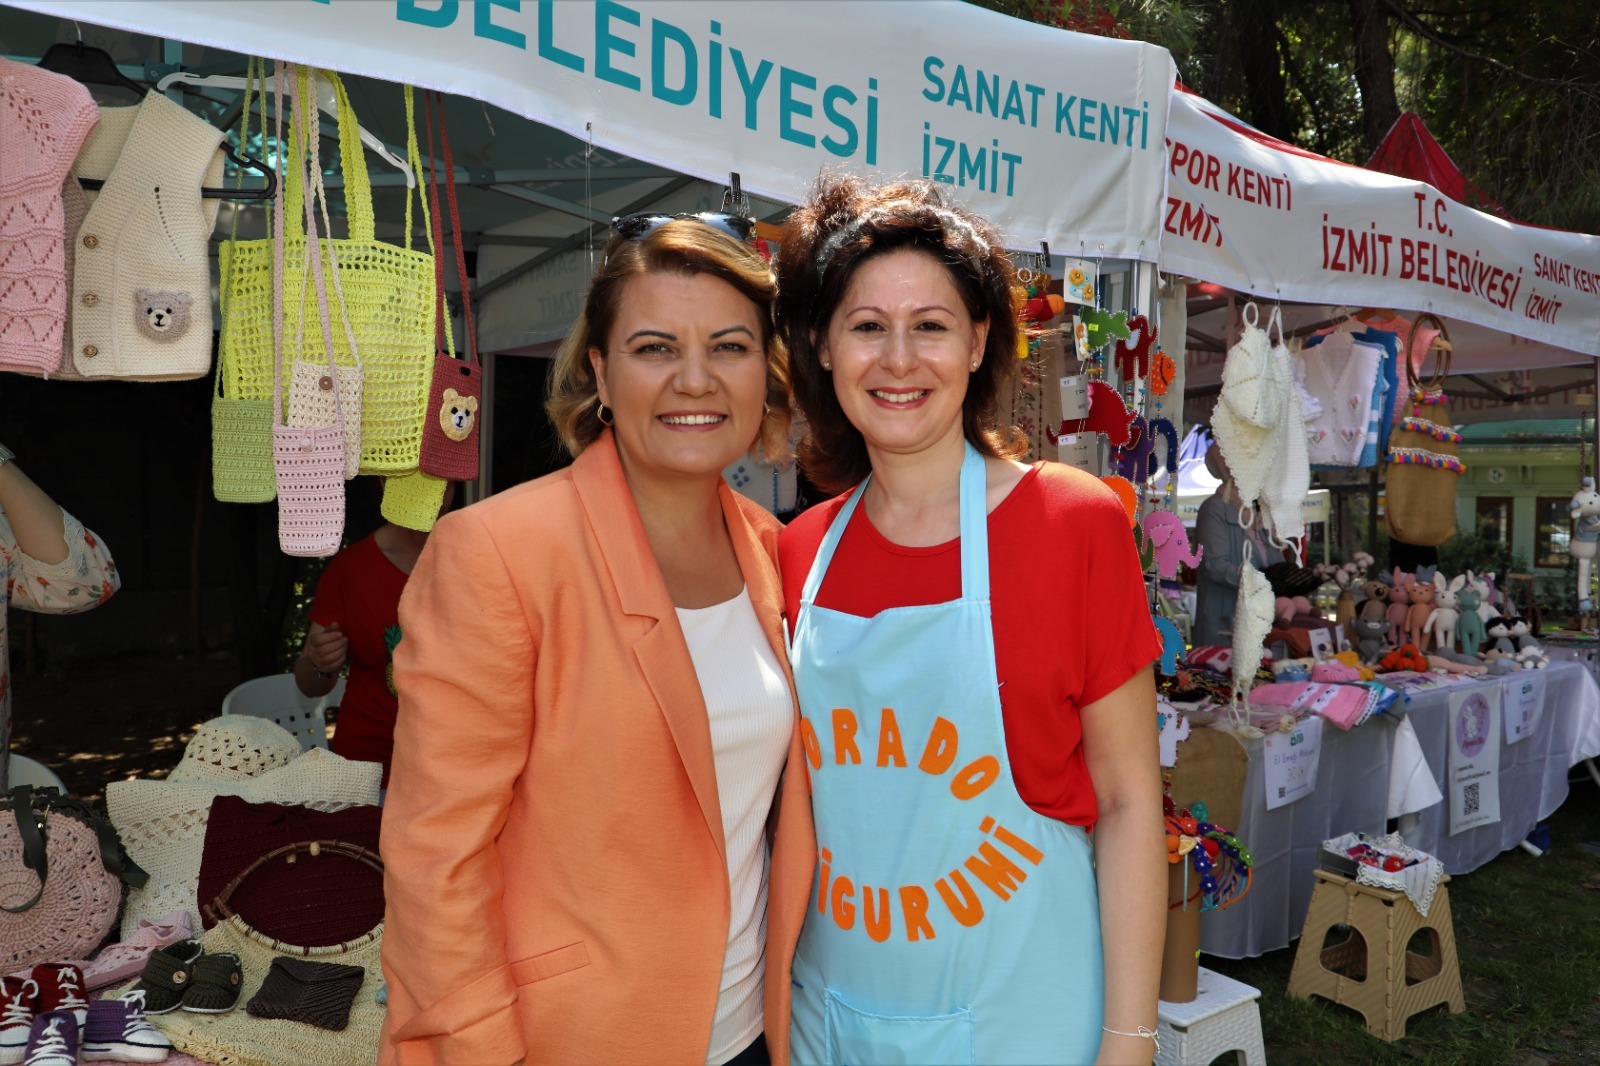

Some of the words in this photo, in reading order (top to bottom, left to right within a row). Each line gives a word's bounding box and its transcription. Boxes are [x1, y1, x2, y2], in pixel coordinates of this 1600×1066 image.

[922, 55, 1046, 128] SANAT
[1055, 91, 1149, 150] KENTİ
[922, 121, 1023, 197] İZMİT
[1166, 137, 1221, 192] POR
[1227, 163, 1292, 211] KENTİ
[1414, 192, 1453, 237] T.C.
[1322, 213, 1393, 277] İZMİT
[1399, 238, 1523, 311] BELEDİYESİ
[1534, 252, 1571, 288] SANAT
[1524, 287, 1562, 325] İZMİT
[800, 708, 1000, 801] ORADO
